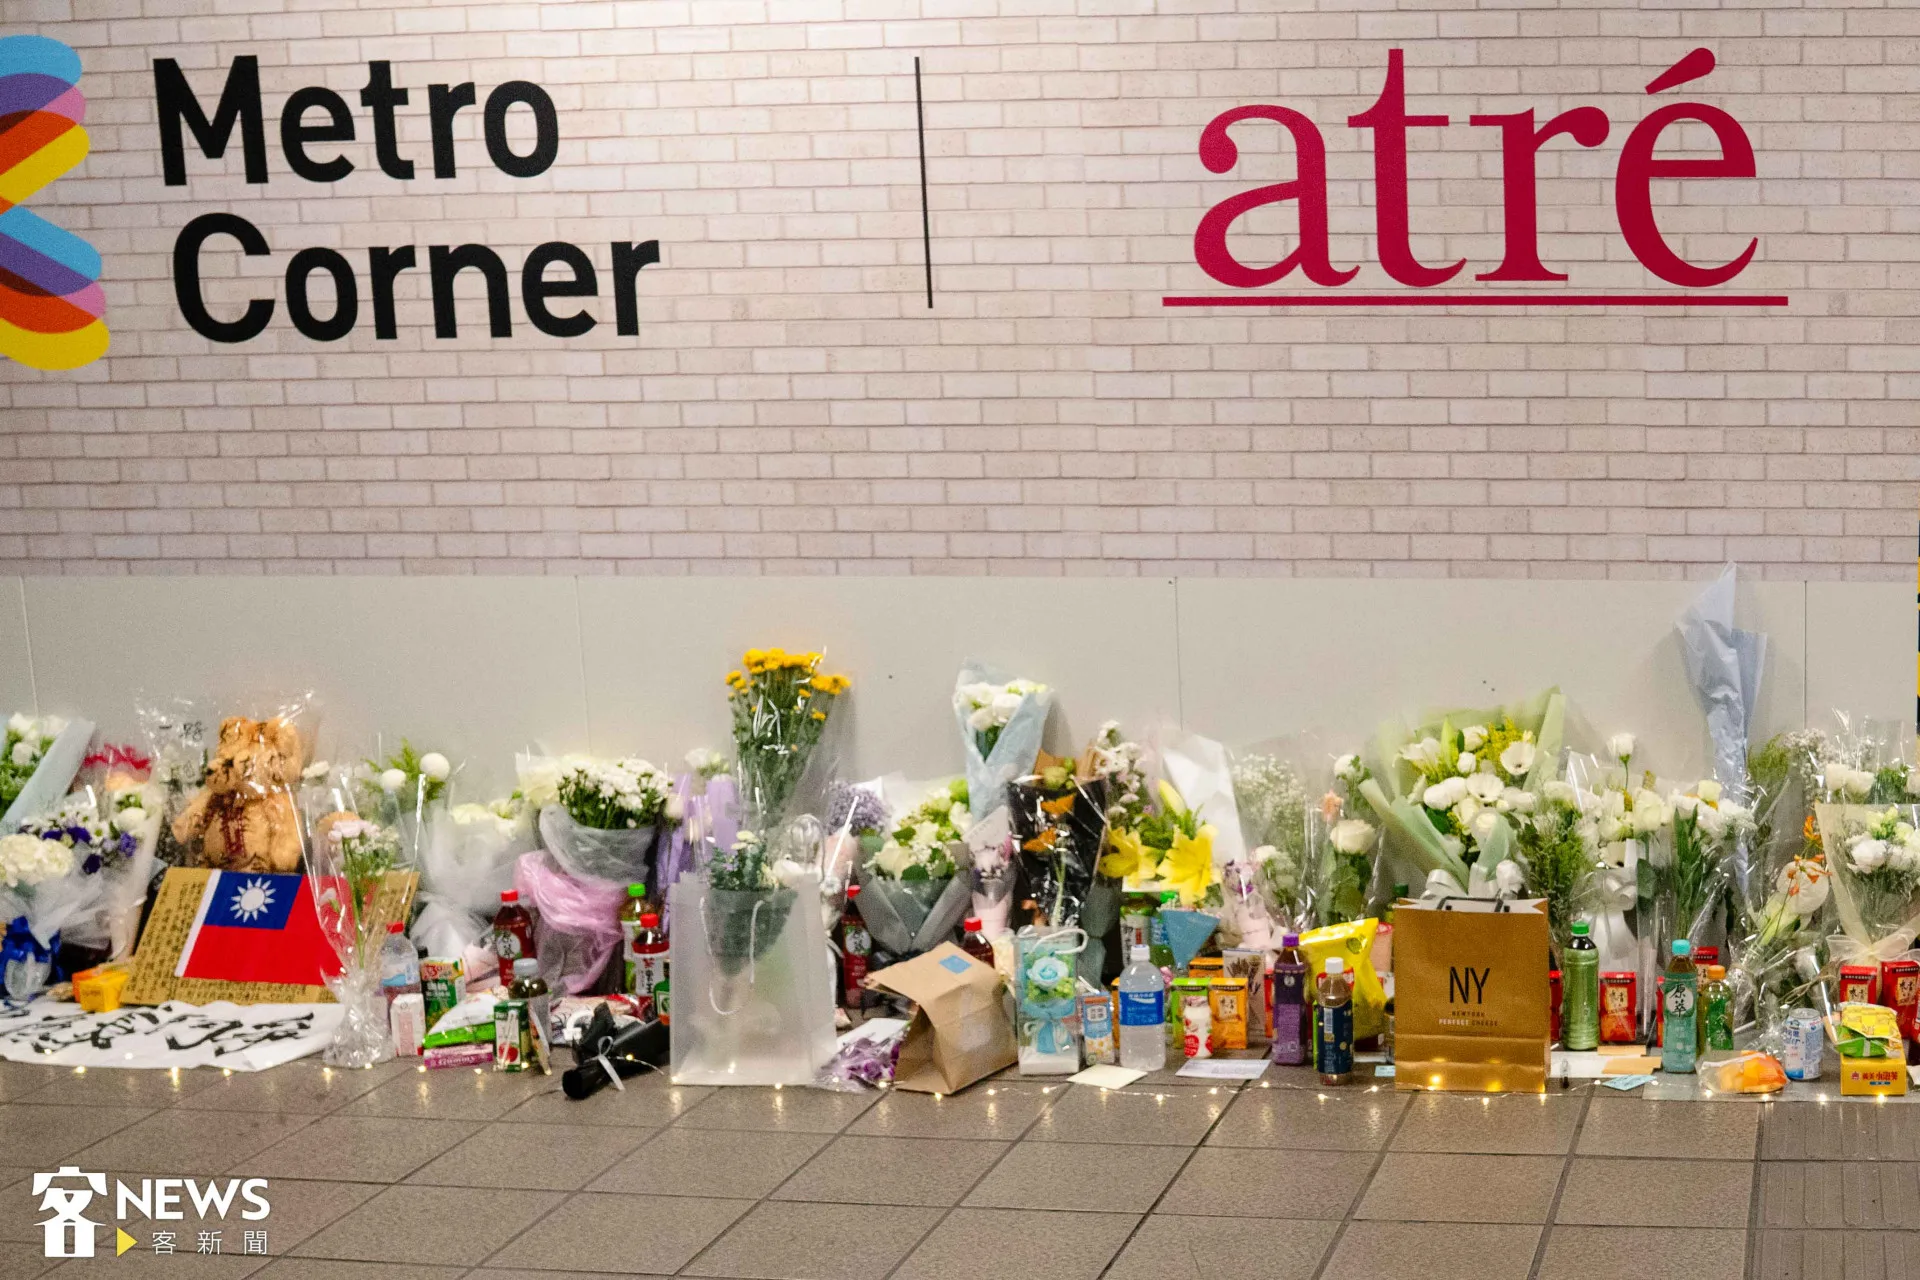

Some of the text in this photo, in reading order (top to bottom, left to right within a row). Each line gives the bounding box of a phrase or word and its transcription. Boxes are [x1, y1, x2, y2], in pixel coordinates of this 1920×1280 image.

[154, 56, 558, 186] Metro
[1194, 47, 1758, 288] atré
[174, 212, 660, 344] Corner
[1438, 1018, 1469, 1026] PERFECT
[1450, 966, 1490, 1004] NY
[1669, 983, 1687, 1018] 原萃
